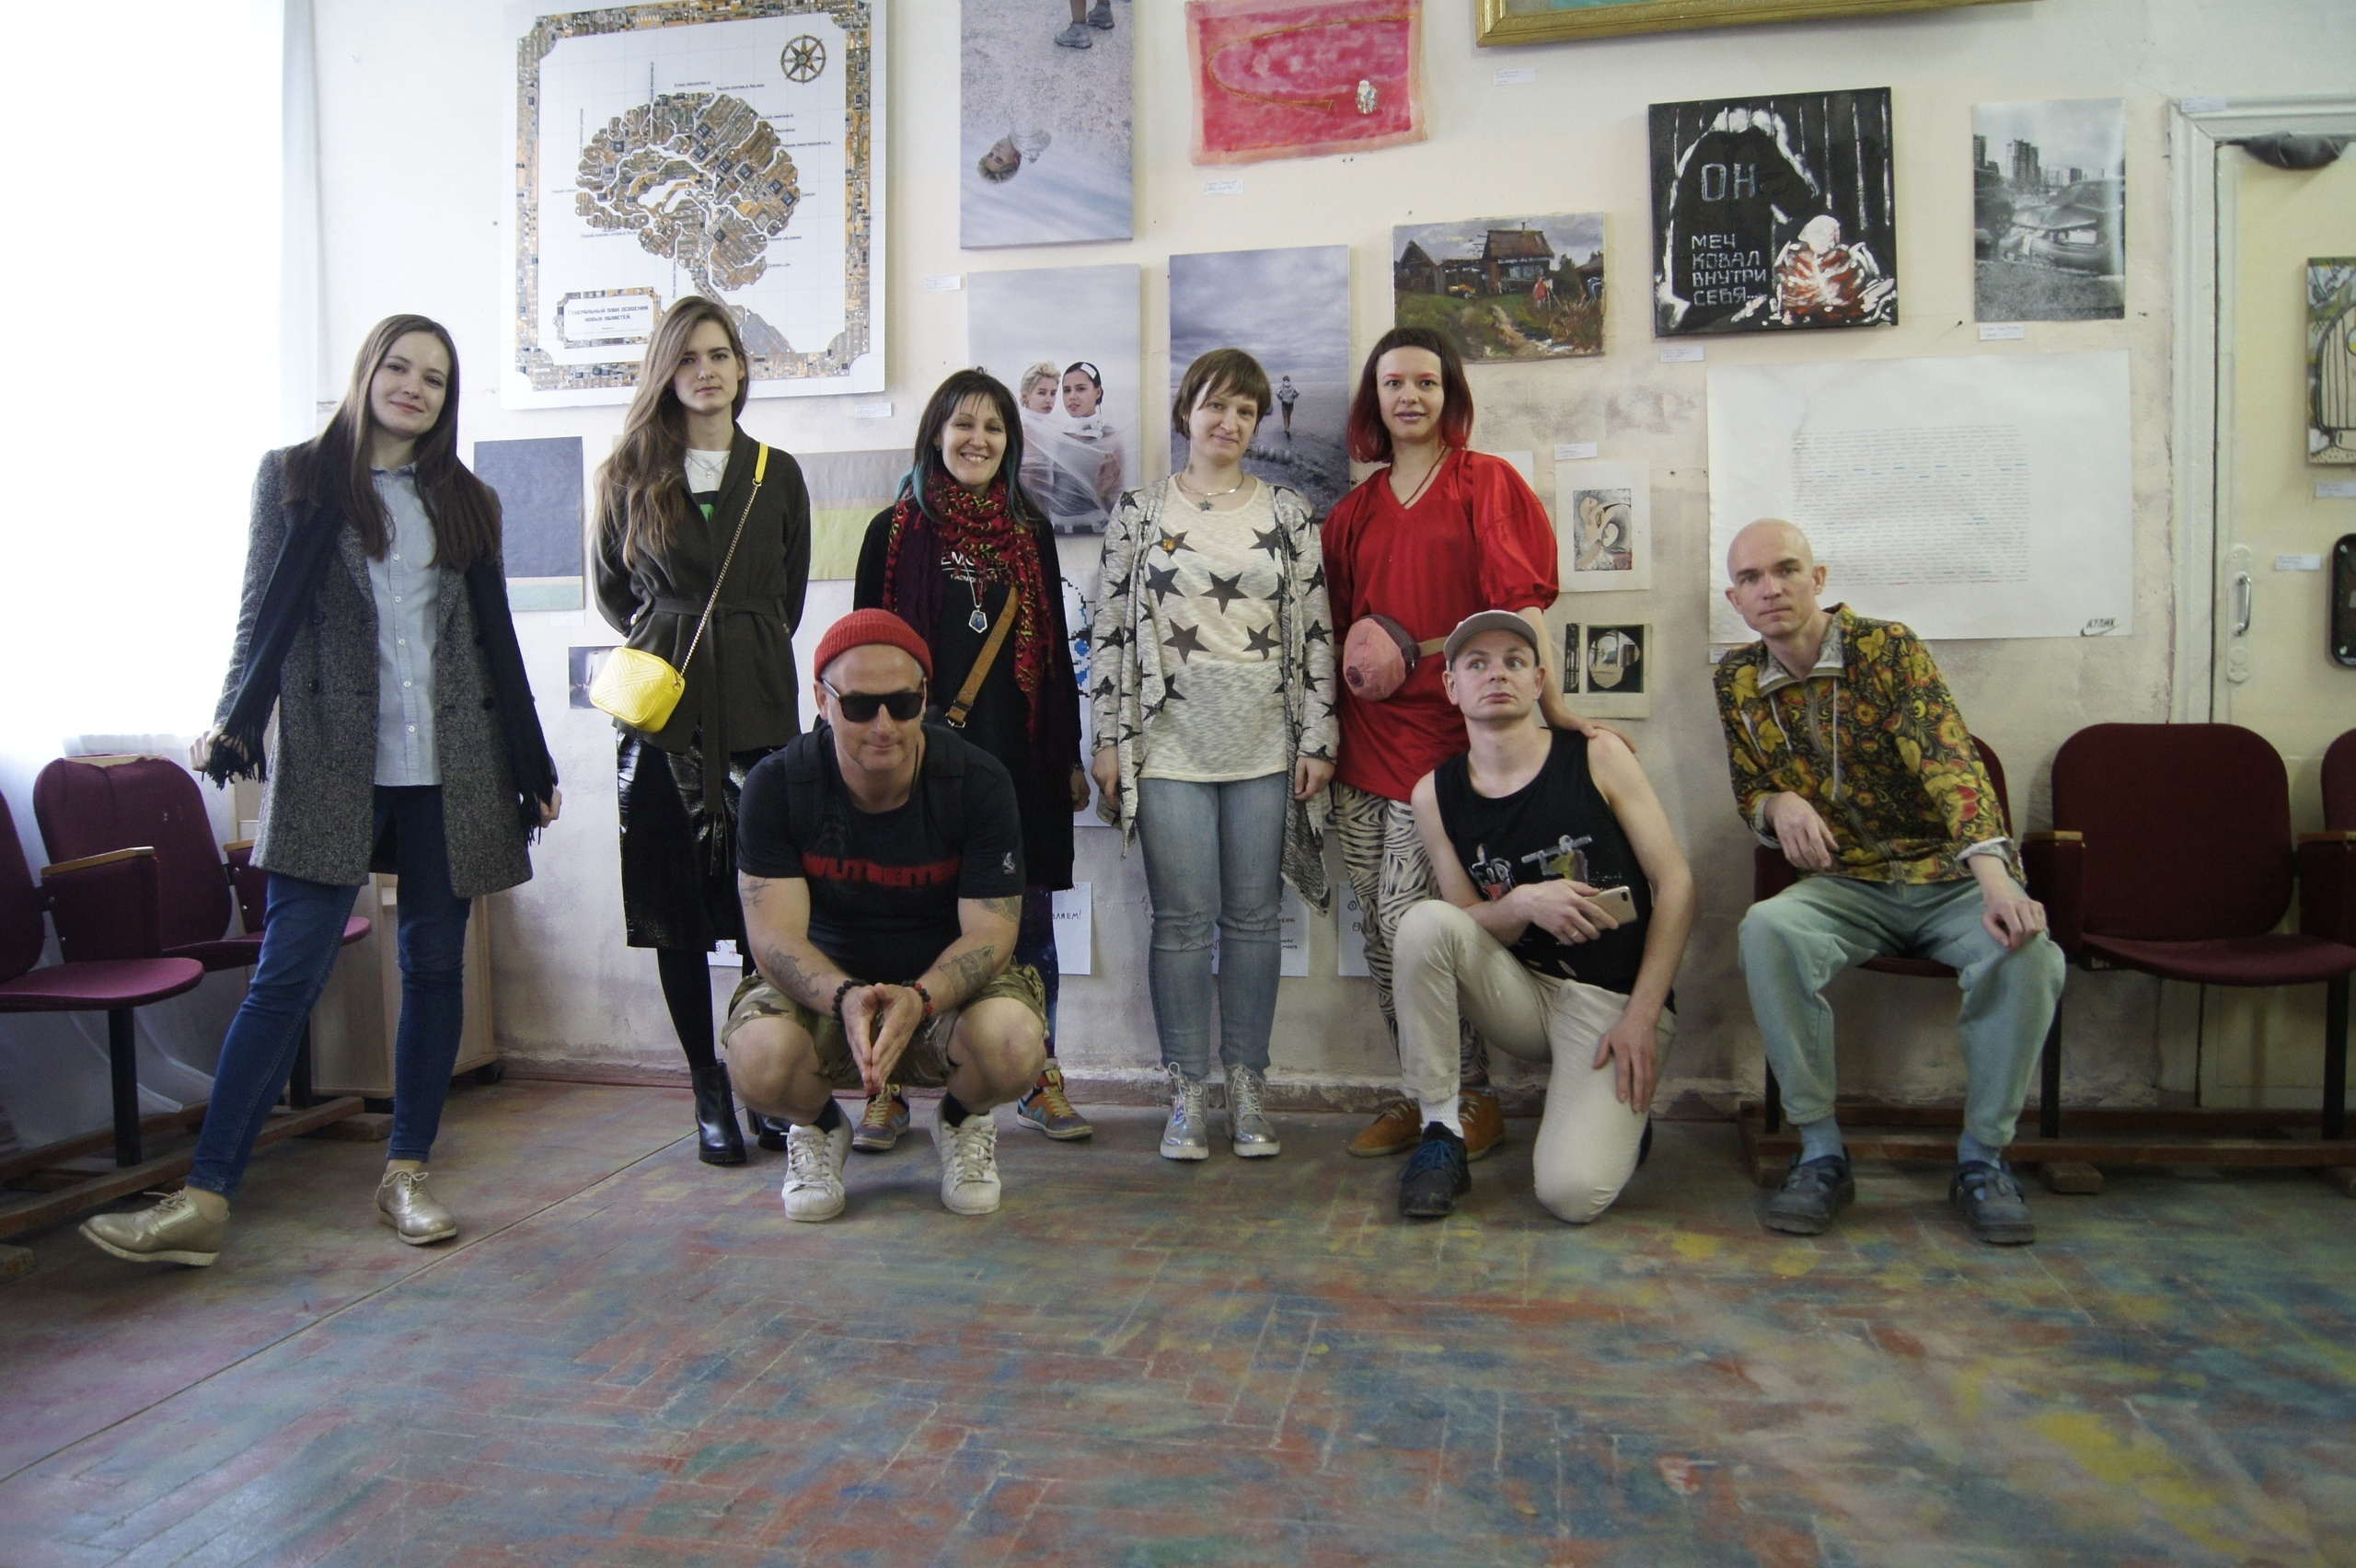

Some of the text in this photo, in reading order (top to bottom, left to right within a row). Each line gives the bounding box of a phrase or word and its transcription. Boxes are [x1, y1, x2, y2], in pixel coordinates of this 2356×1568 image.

[1701, 163, 1756, 202] ОН
[1691, 233, 1737, 249] МЕЧ
[1692, 250, 1761, 270] КОВАЛ
[1692, 268, 1767, 288] ВНУТРИ
